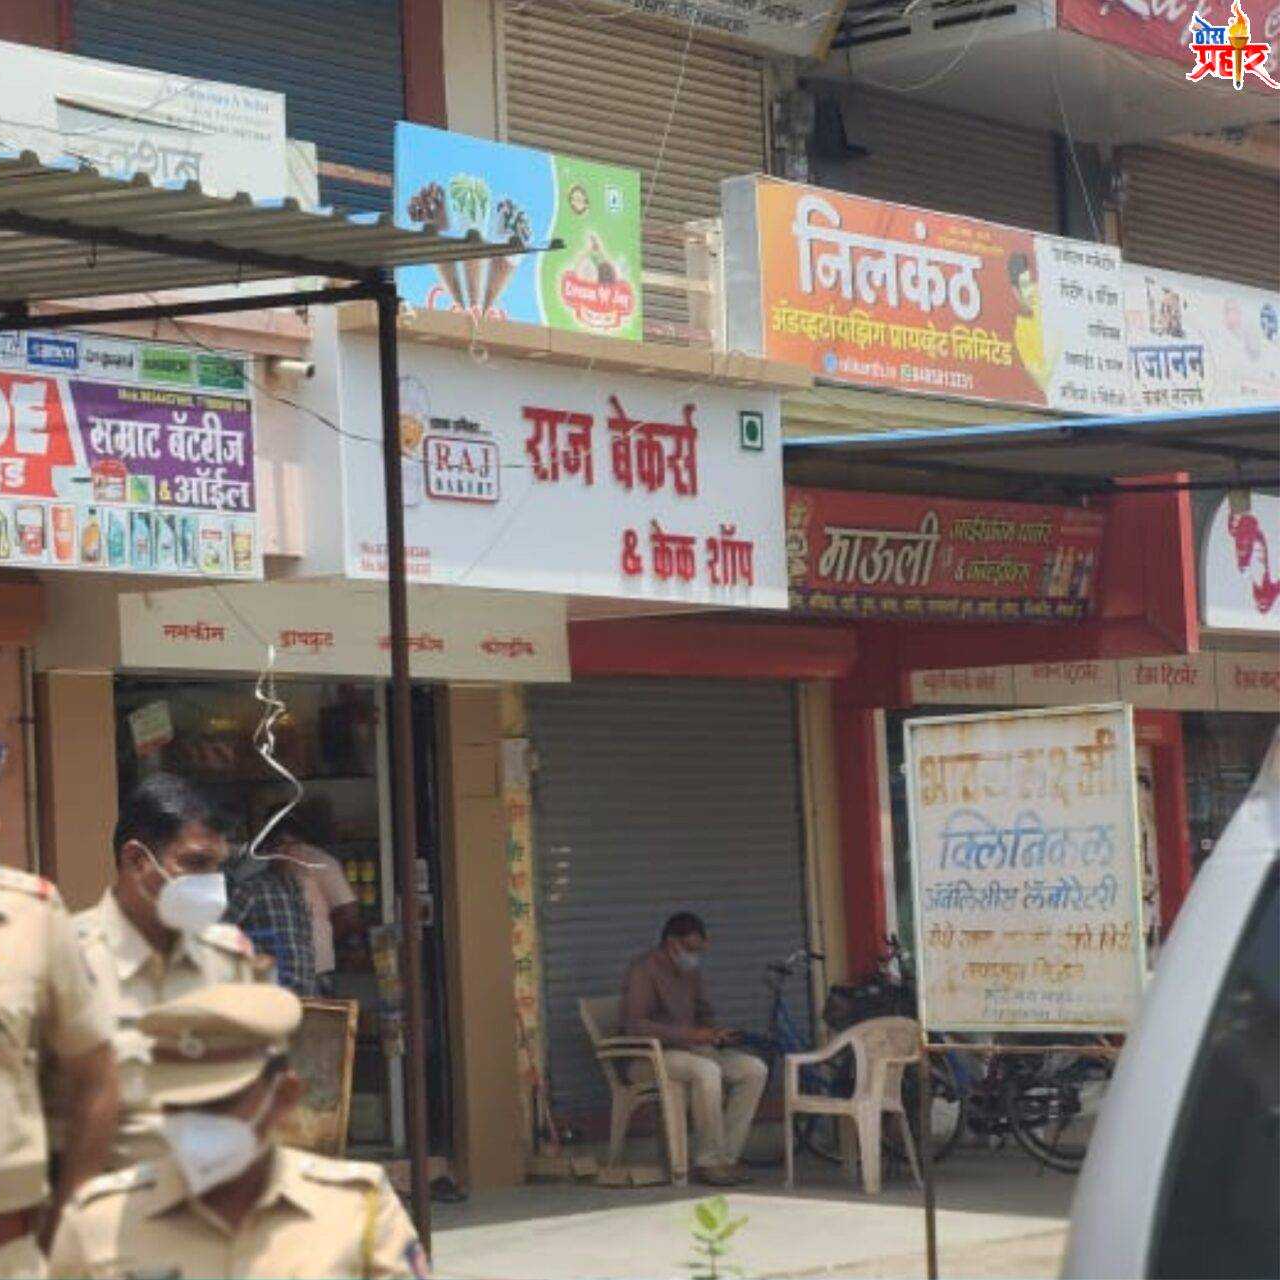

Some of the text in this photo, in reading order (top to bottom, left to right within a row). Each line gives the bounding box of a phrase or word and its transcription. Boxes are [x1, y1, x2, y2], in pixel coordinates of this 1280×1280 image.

[792, 194, 984, 322] निलकंठ
[1128, 343, 1205, 380] जानन
[86, 411, 246, 469] सम्राट बॅटरीज
[435, 442, 491, 478] RAJ
[522, 394, 698, 497] राज बेकर्स
[621, 519, 755, 587] & केक शॉप
[819, 510, 941, 587] माऊली
